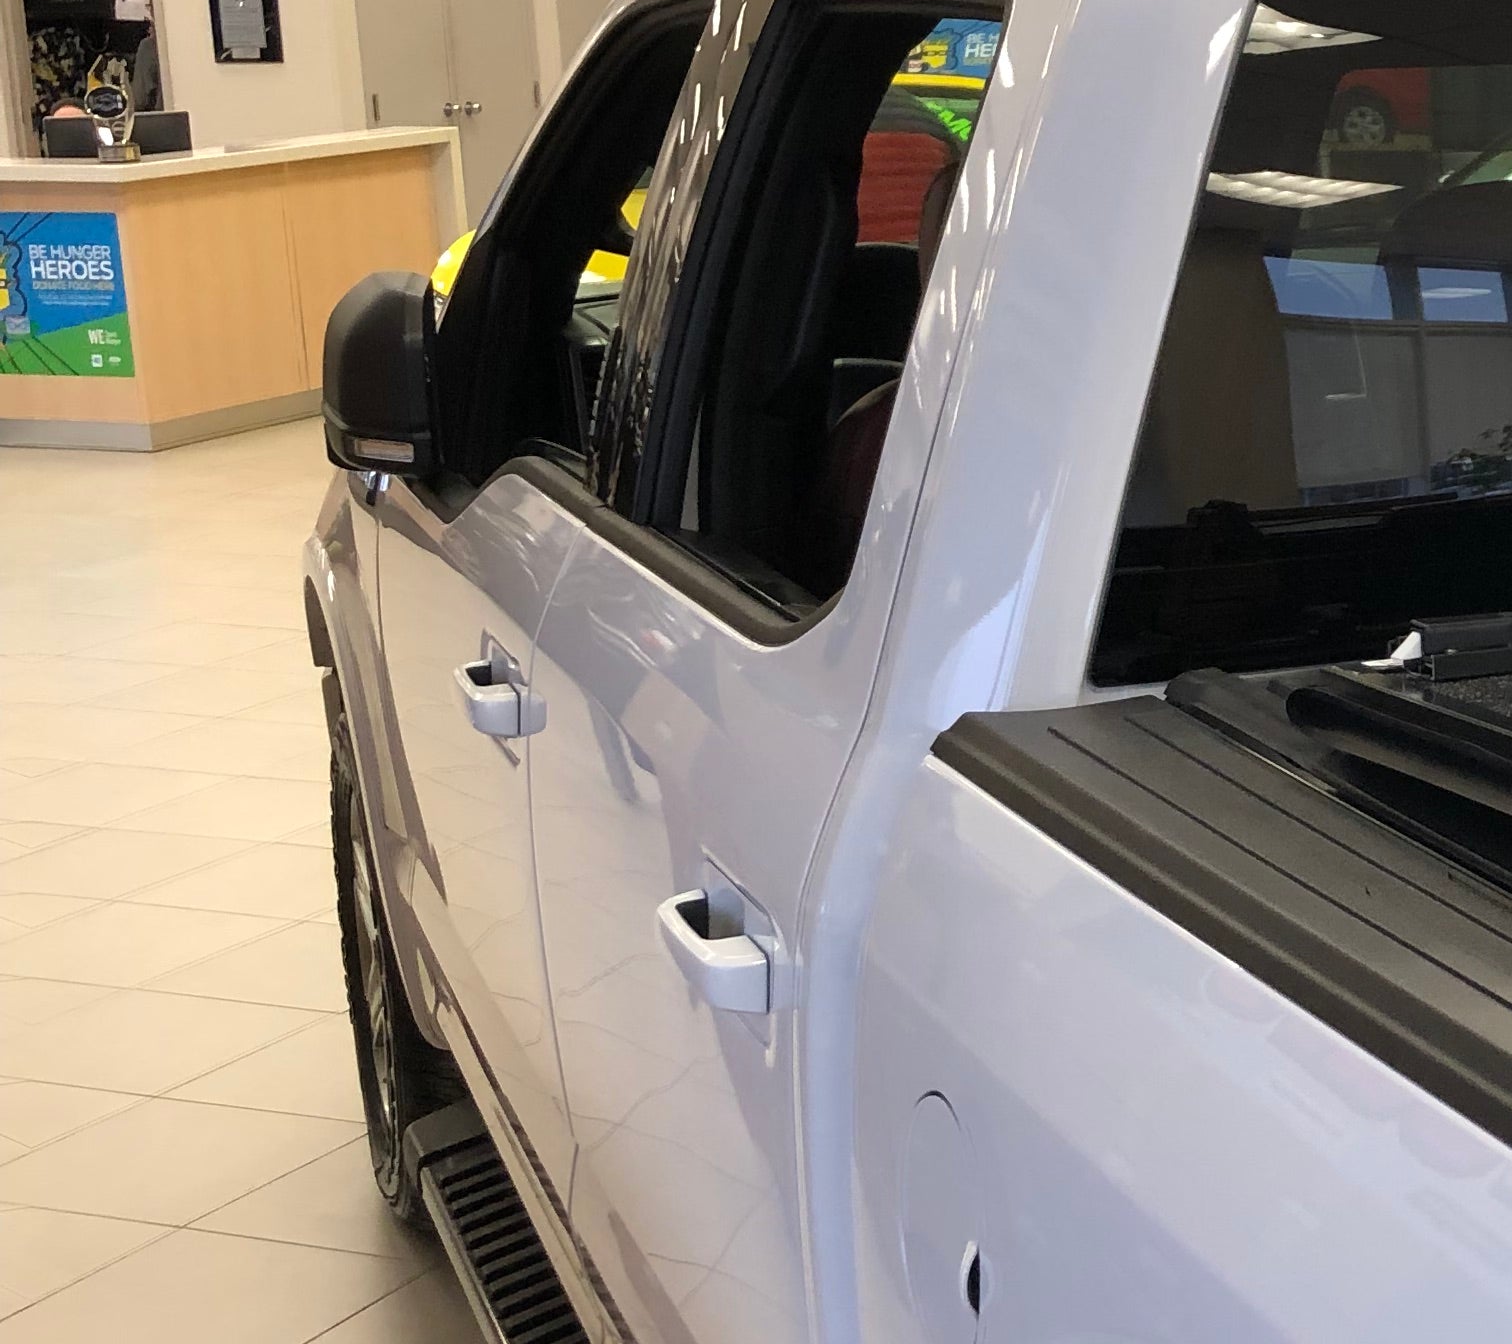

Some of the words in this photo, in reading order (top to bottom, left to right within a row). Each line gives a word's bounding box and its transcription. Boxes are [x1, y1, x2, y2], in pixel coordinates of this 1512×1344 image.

[28, 244, 47, 259] BE
[50, 245, 111, 261] HUNGER
[30, 260, 114, 281] HEROES
